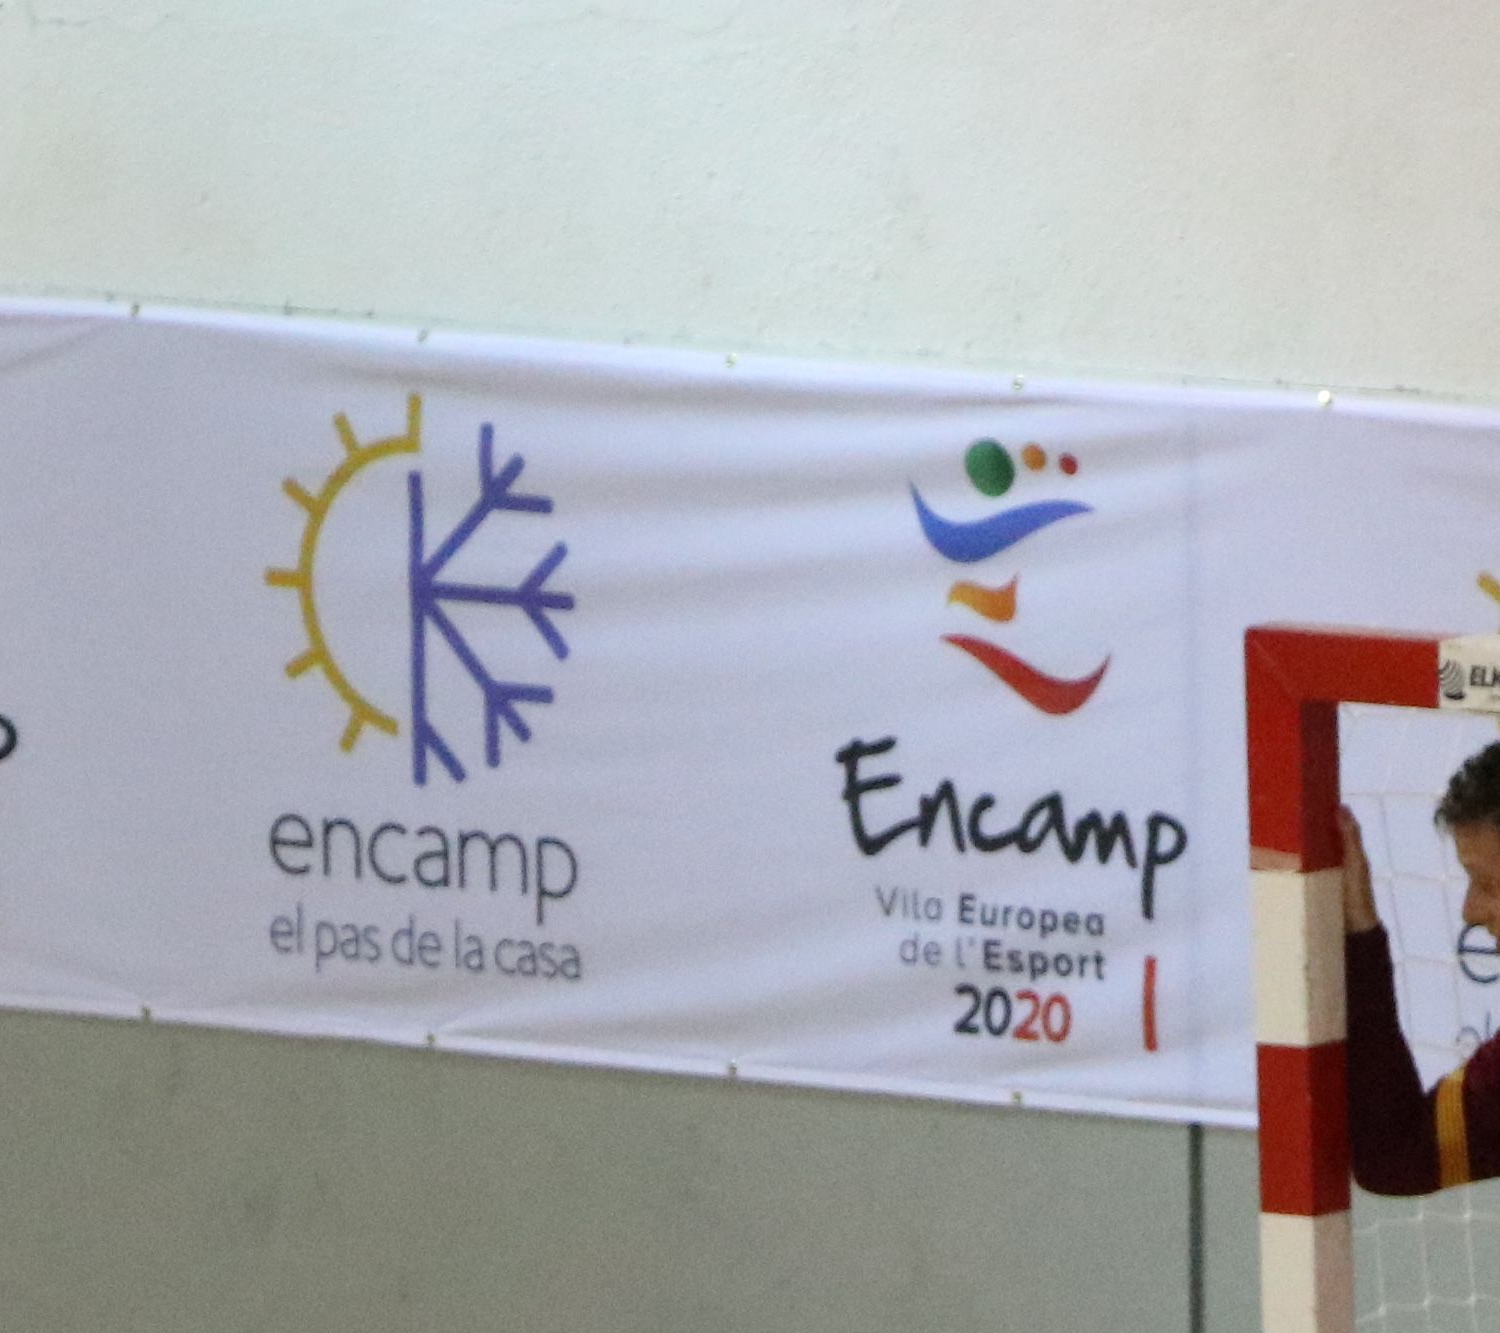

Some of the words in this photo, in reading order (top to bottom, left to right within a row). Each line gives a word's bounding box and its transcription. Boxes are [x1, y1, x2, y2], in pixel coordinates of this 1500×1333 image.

[835, 736, 1188, 920] Encamp
[269, 812, 579, 926] encamp
[269, 901, 303, 955] el
[314, 920, 382, 973] pas
[391, 914, 443, 968] de
[454, 917, 486, 973] la
[495, 938, 582, 980] casa
[874, 885, 943, 922] Vila
[958, 893, 1106, 938] Europea
[900, 934, 942, 967] de
[955, 937, 1106, 981] l'Esport
[954, 982, 1073, 1043] 2020
